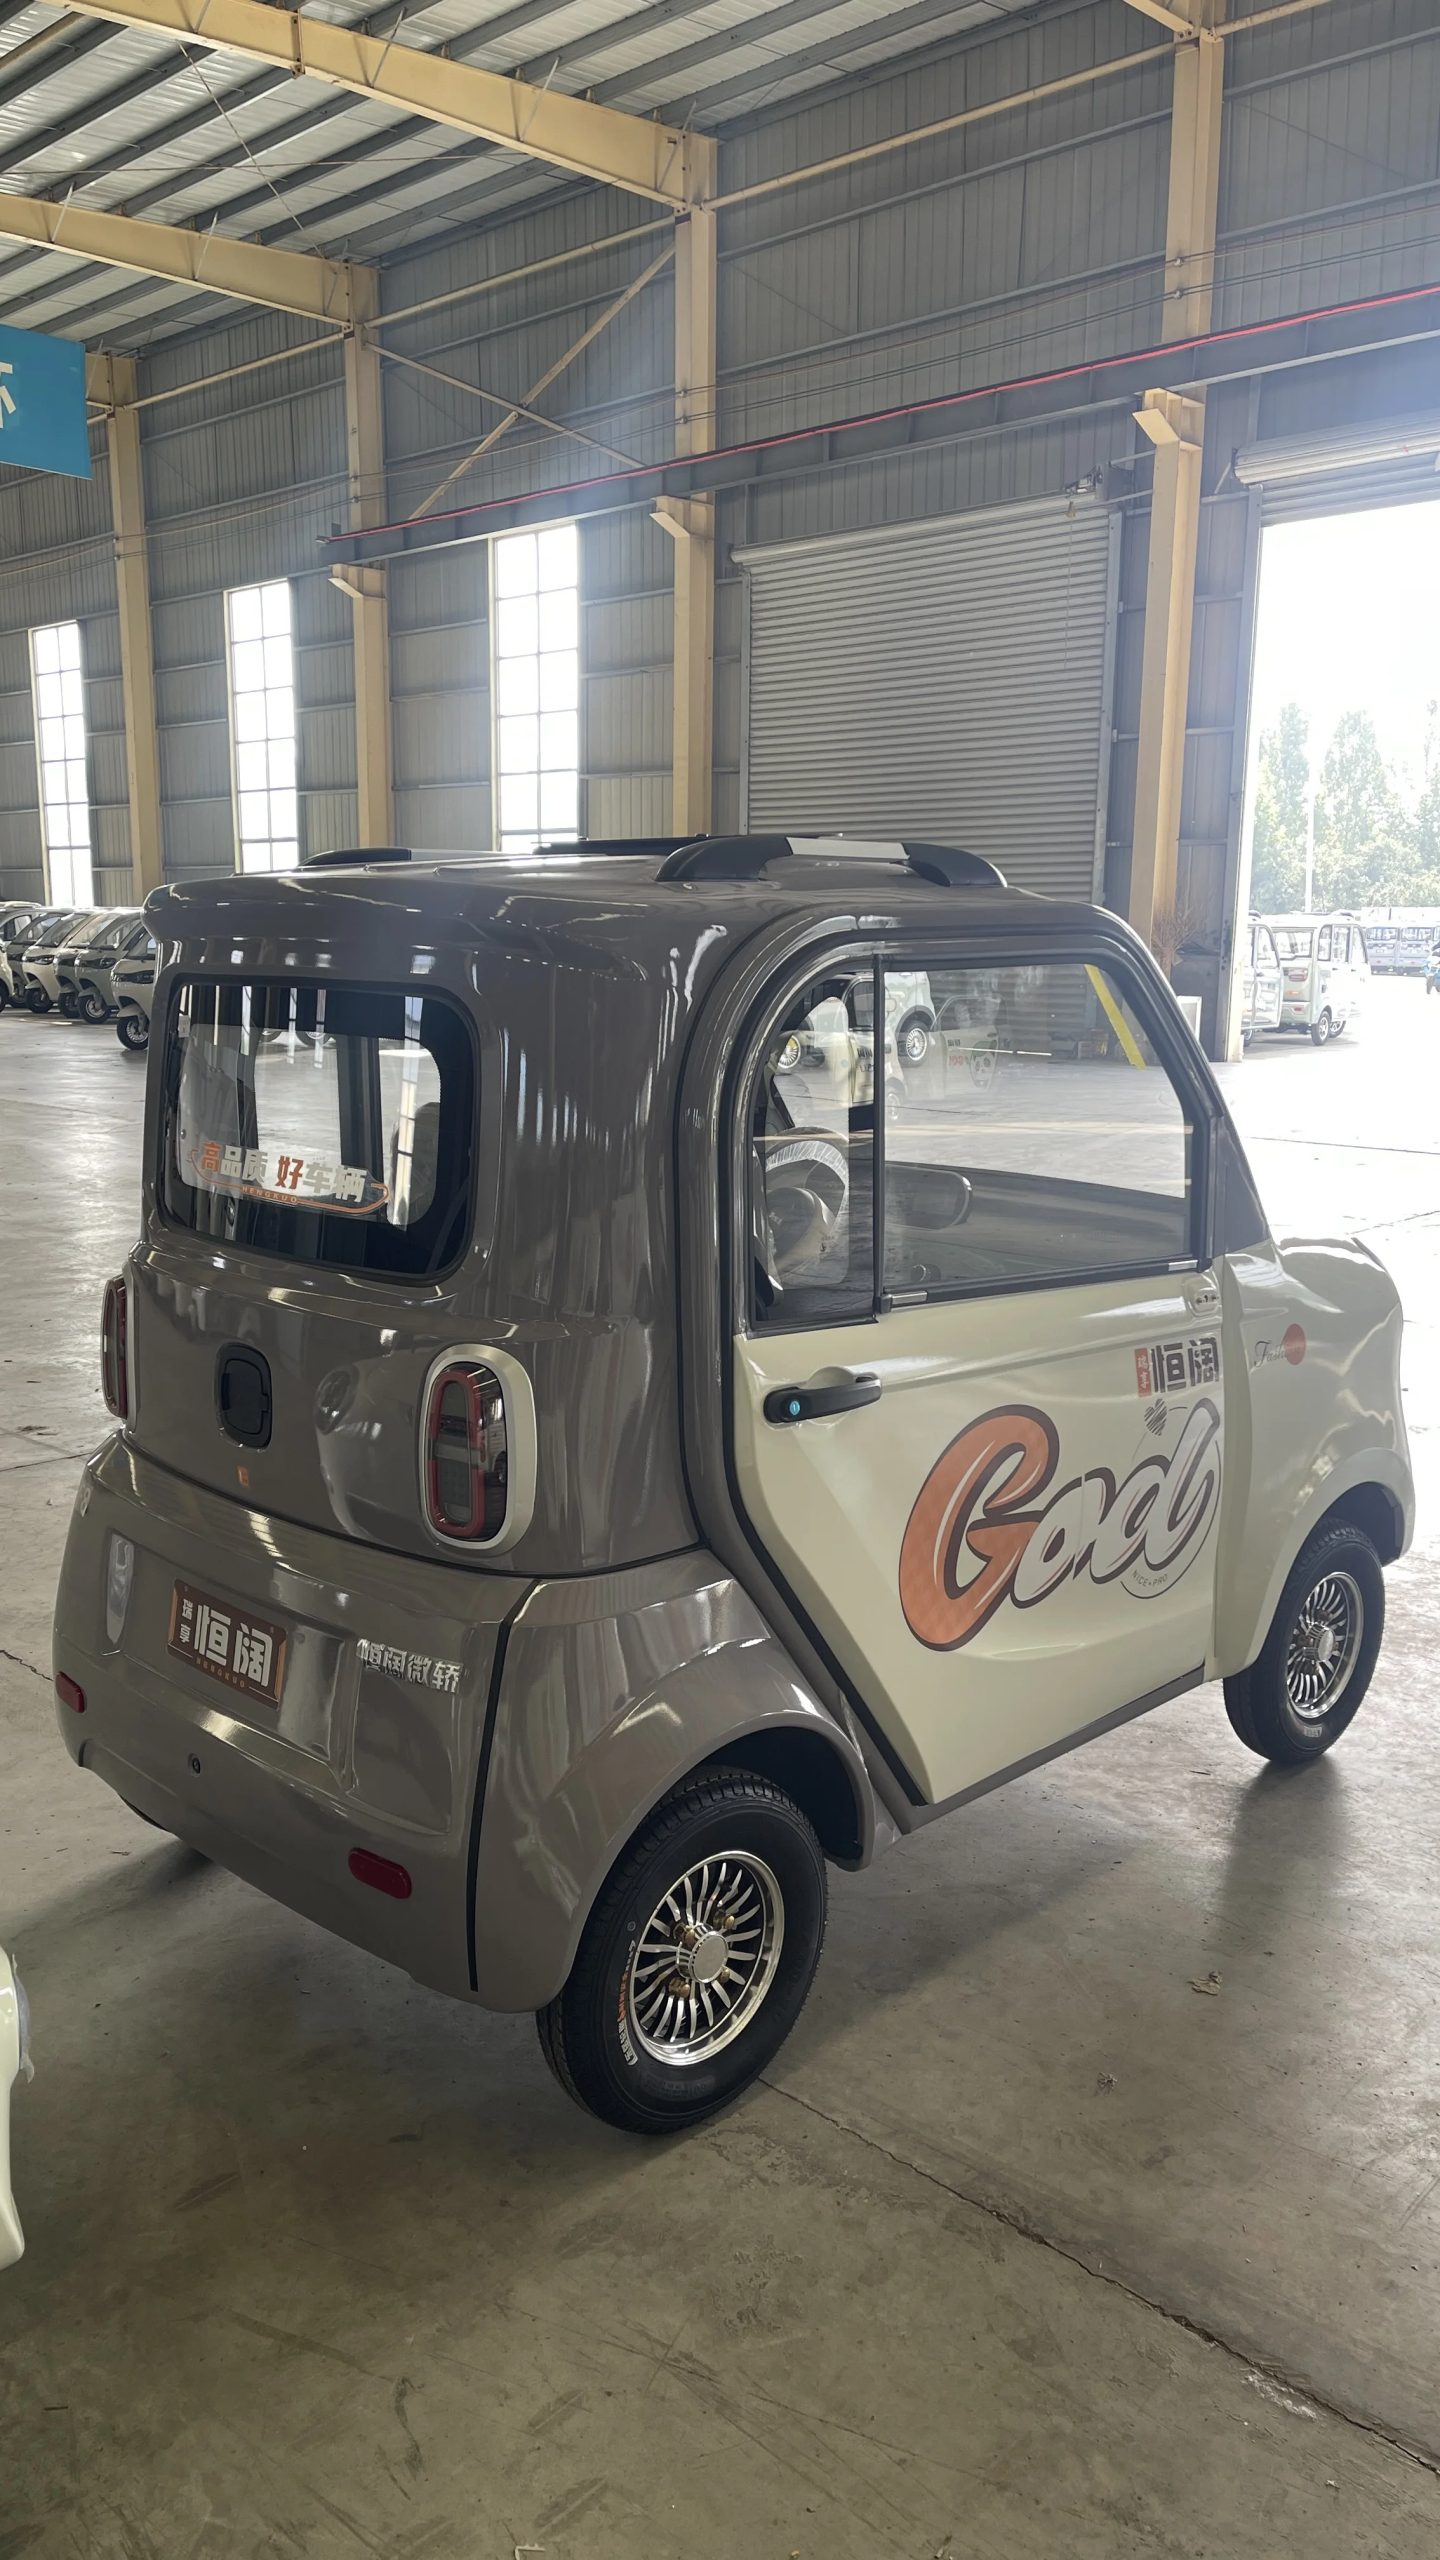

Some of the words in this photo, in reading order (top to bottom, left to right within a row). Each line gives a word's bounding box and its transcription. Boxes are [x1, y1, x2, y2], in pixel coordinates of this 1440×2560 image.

[203, 1141, 268, 1183] 高品质
[275, 1155, 367, 1203] 好车辆
[242, 1186, 298, 1203] HENGKUO
[1151, 1337, 1219, 1393] 恒阔
[899, 1397, 1220, 1652] Good
[194, 1605, 272, 1687] 恒阔
[357, 1638, 460, 1693] 恒阔微轿
